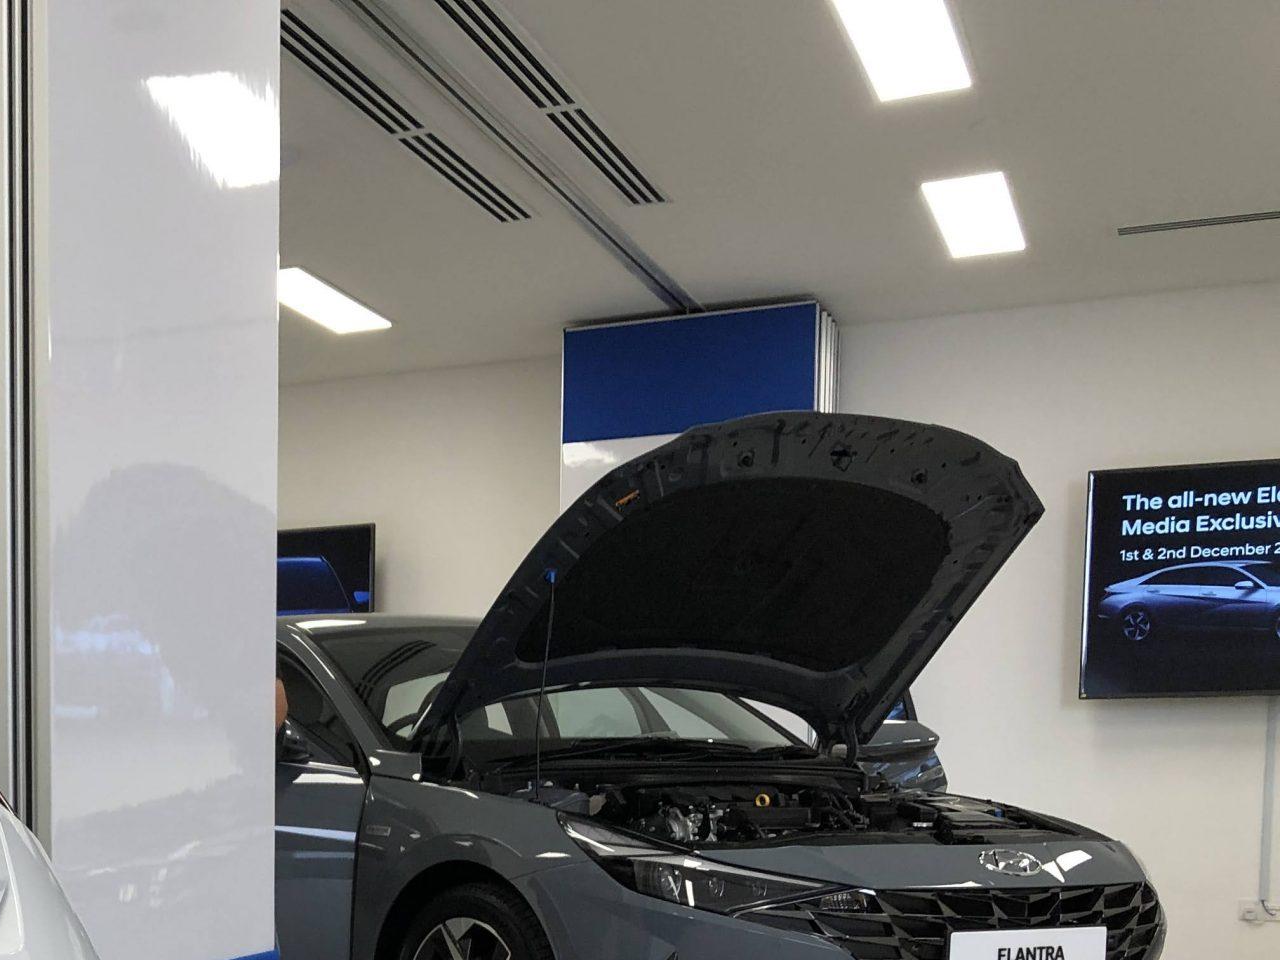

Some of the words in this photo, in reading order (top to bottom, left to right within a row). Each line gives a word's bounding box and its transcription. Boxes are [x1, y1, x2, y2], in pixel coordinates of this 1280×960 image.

[1122, 493, 1163, 511] The
[1167, 490, 1252, 509] all-new
[1257, 486, 1280, 503] El
[1122, 516, 1190, 536] Media
[1120, 549, 1139, 561] 1st
[1142, 548, 1154, 560] &
[1157, 545, 1186, 560] 2nd
[1190, 543, 1271, 558] December
